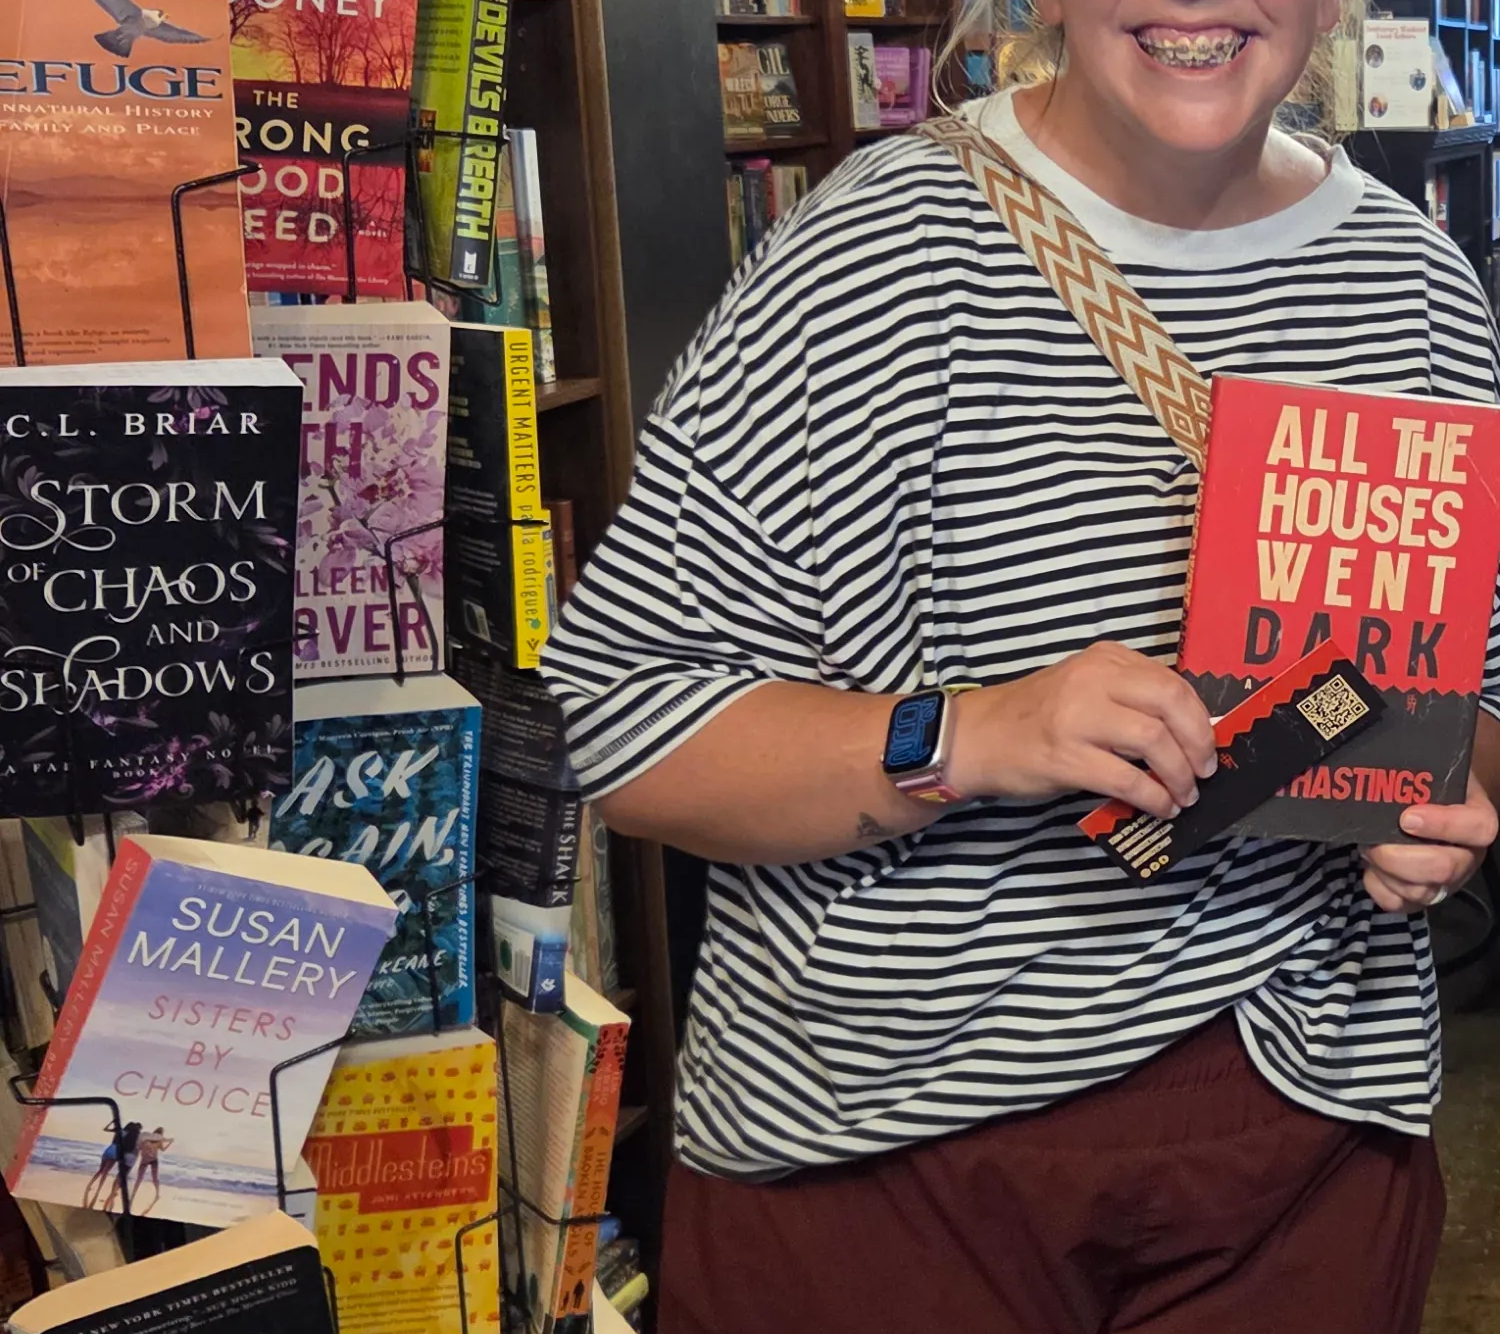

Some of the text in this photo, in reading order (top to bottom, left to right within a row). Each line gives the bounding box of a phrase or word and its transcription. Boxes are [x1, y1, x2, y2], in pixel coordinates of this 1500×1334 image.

[0, 59, 225, 103] EFUGE
[469, 0, 509, 113] DEVIL'S
[79, 123, 127, 136] AND
[136, 123, 201, 136] PLACE
[124, 104, 214, 120] HISTORY
[252, 88, 300, 110] THE
[235, 115, 371, 155] RONG
[455, 113, 500, 241] BREATH
[243, 208, 338, 244] EED
[358, 228, 388, 239] NOVEL
[508, 340, 533, 410] URGENT
[6, 412, 263, 439] C.L. BRIAR
[511, 415, 537, 495] MATTERS
[1265, 404, 1474, 485] ALL THE
[0, 478, 268, 549] STORM
[1257, 472, 1463, 550] HOUSES
[7, 559, 258, 625] OF CHAOS
[1256, 539, 1457, 616] WENT
[145, 619, 221, 647] AND
[320, 656, 391, 668] BESTSELLING
[398, 653, 434, 664] UTHO
[1243, 605, 1448, 680] DARK
[0, 635, 277, 716] SHADOWS
[1244, 677, 1254, 691] A
[89, 751, 190, 771] FANTASY
[205, 743, 276, 761] NOEL
[274, 744, 441, 818] ASK
[1290, 765, 1433, 804] HASTINGS
[269, 808, 460, 869] AIN,
[99, 857, 139, 940] SUSAN
[171, 896, 346, 959] SUSAN
[126, 930, 358, 1000] MALLERY
[148, 995, 298, 1041] SISTERS
[185, 1041, 235, 1071] BY
[113, 1070, 272, 1119] CHOICE
[122, 1307, 163, 1326] YORK
[165, 1291, 209, 1313] TIMES
[211, 1264, 295, 1297] BESTSELLER
